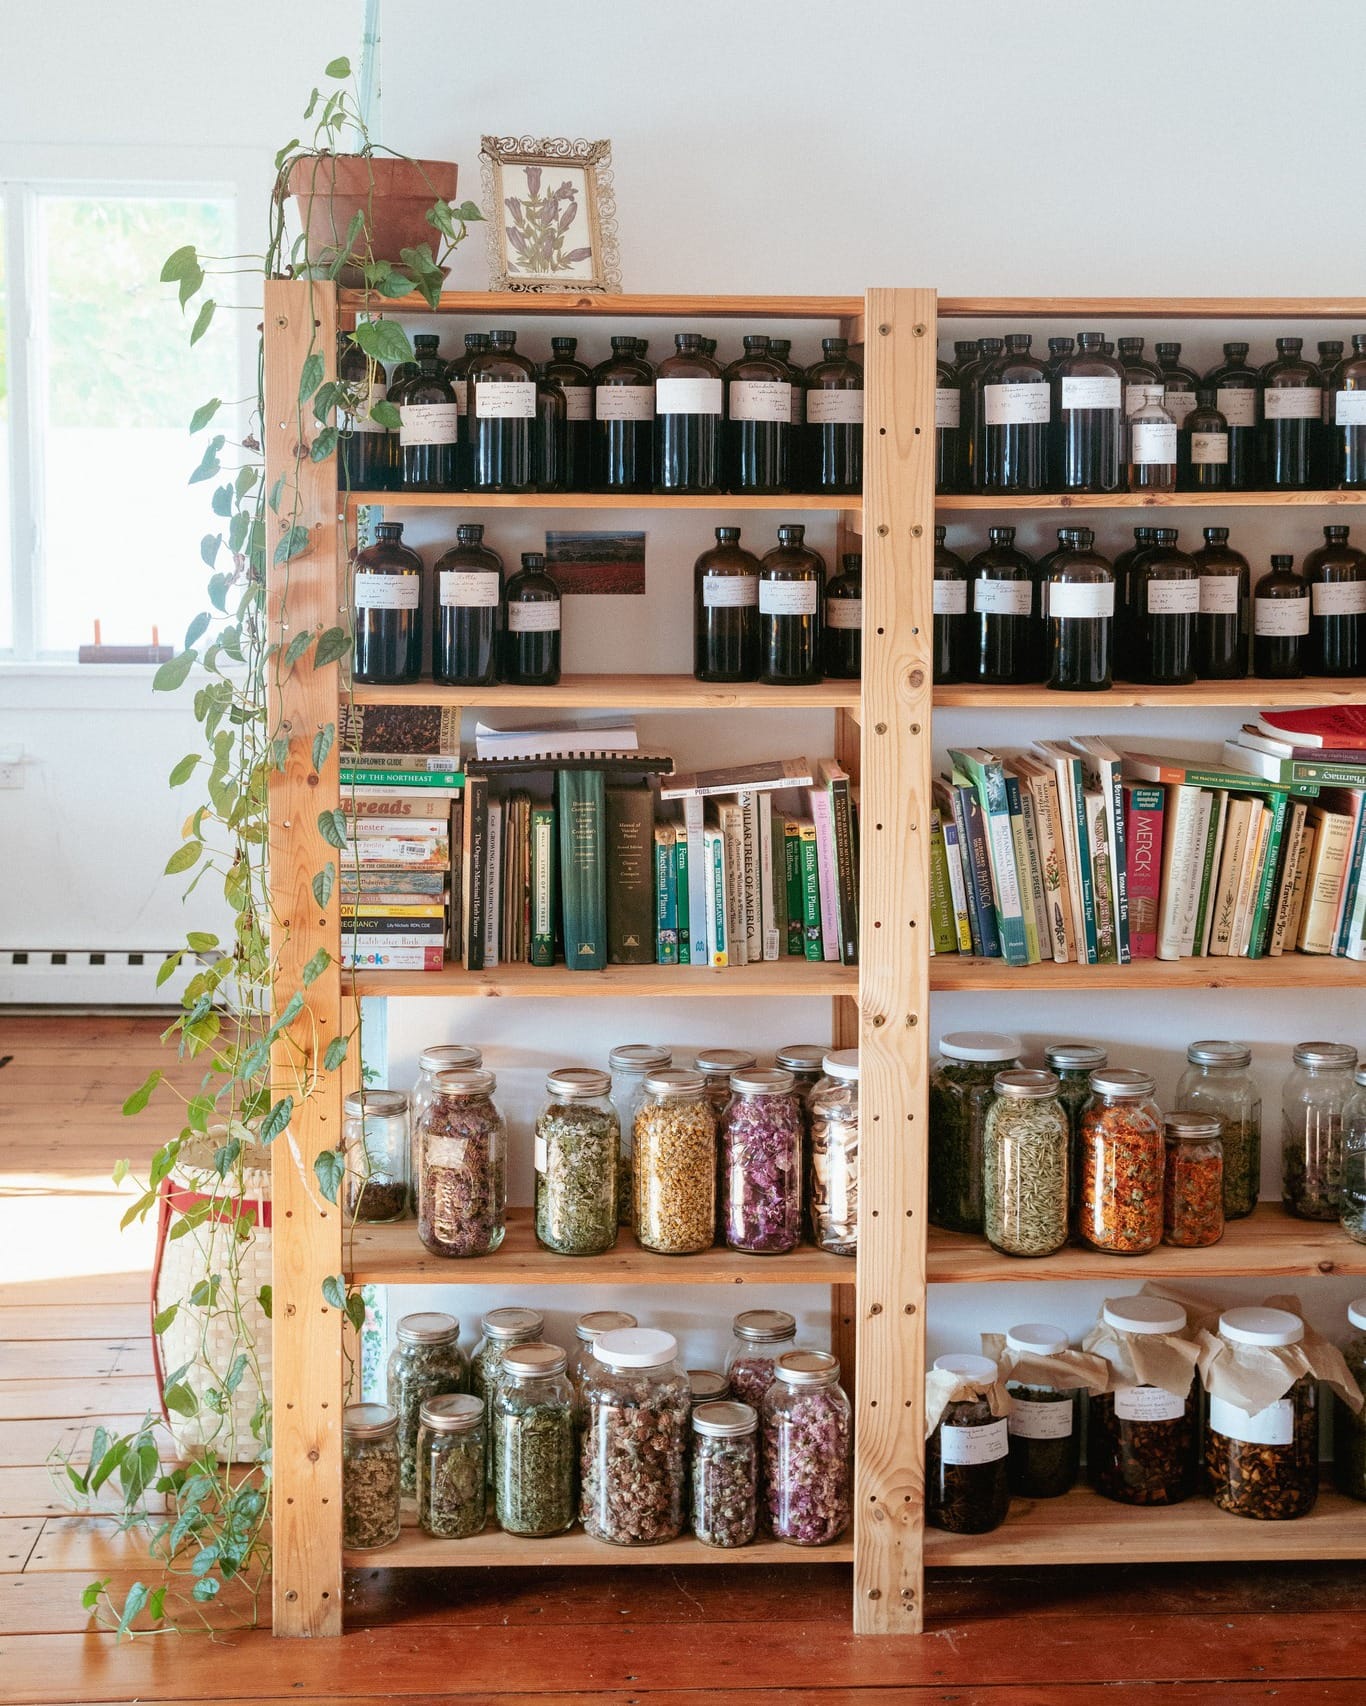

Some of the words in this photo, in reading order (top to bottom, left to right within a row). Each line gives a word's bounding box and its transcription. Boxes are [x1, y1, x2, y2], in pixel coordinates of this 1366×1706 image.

[1322, 771, 1366, 784] Pharmacy
[742, 791, 751, 839] FAMILIAR
[1275, 802, 1285, 832] WORMSER
[1096, 820, 1105, 864] INVASIVE
[1136, 816, 1152, 872] MERCK
[472, 846, 481, 870] Organic
[660, 850, 668, 891] Medicinal
[678, 848, 687, 870] Ferns
[744, 841, 752, 873] TREES
[806, 846, 815, 871] Edible
[1016, 828, 1024, 865] Wildcrafted
[1022, 867, 1030, 910] Fermentation
[1030, 848, 1038, 874] INVASIVE
[746, 876, 753, 890] OF
[807, 874, 816, 893] Wild
[935, 857, 945, 898] Nursing
[940, 900, 949, 928] Drug
[978, 870, 991, 909] PHYSICA
[1033, 874, 1041, 899] SPECIES
[1099, 866, 1107, 898] PLANT
[1119, 872, 1127, 897] THOMAS
[660, 894, 668, 918] Plants
[746, 891, 754, 939] AMERICA
[808, 896, 816, 920] Plants
[1280, 882, 1293, 920] Traveler's
[1101, 899, 1111, 946] MEDICINE
[1276, 921, 1287, 936] Joy
[351, 953, 390, 965] weeks
